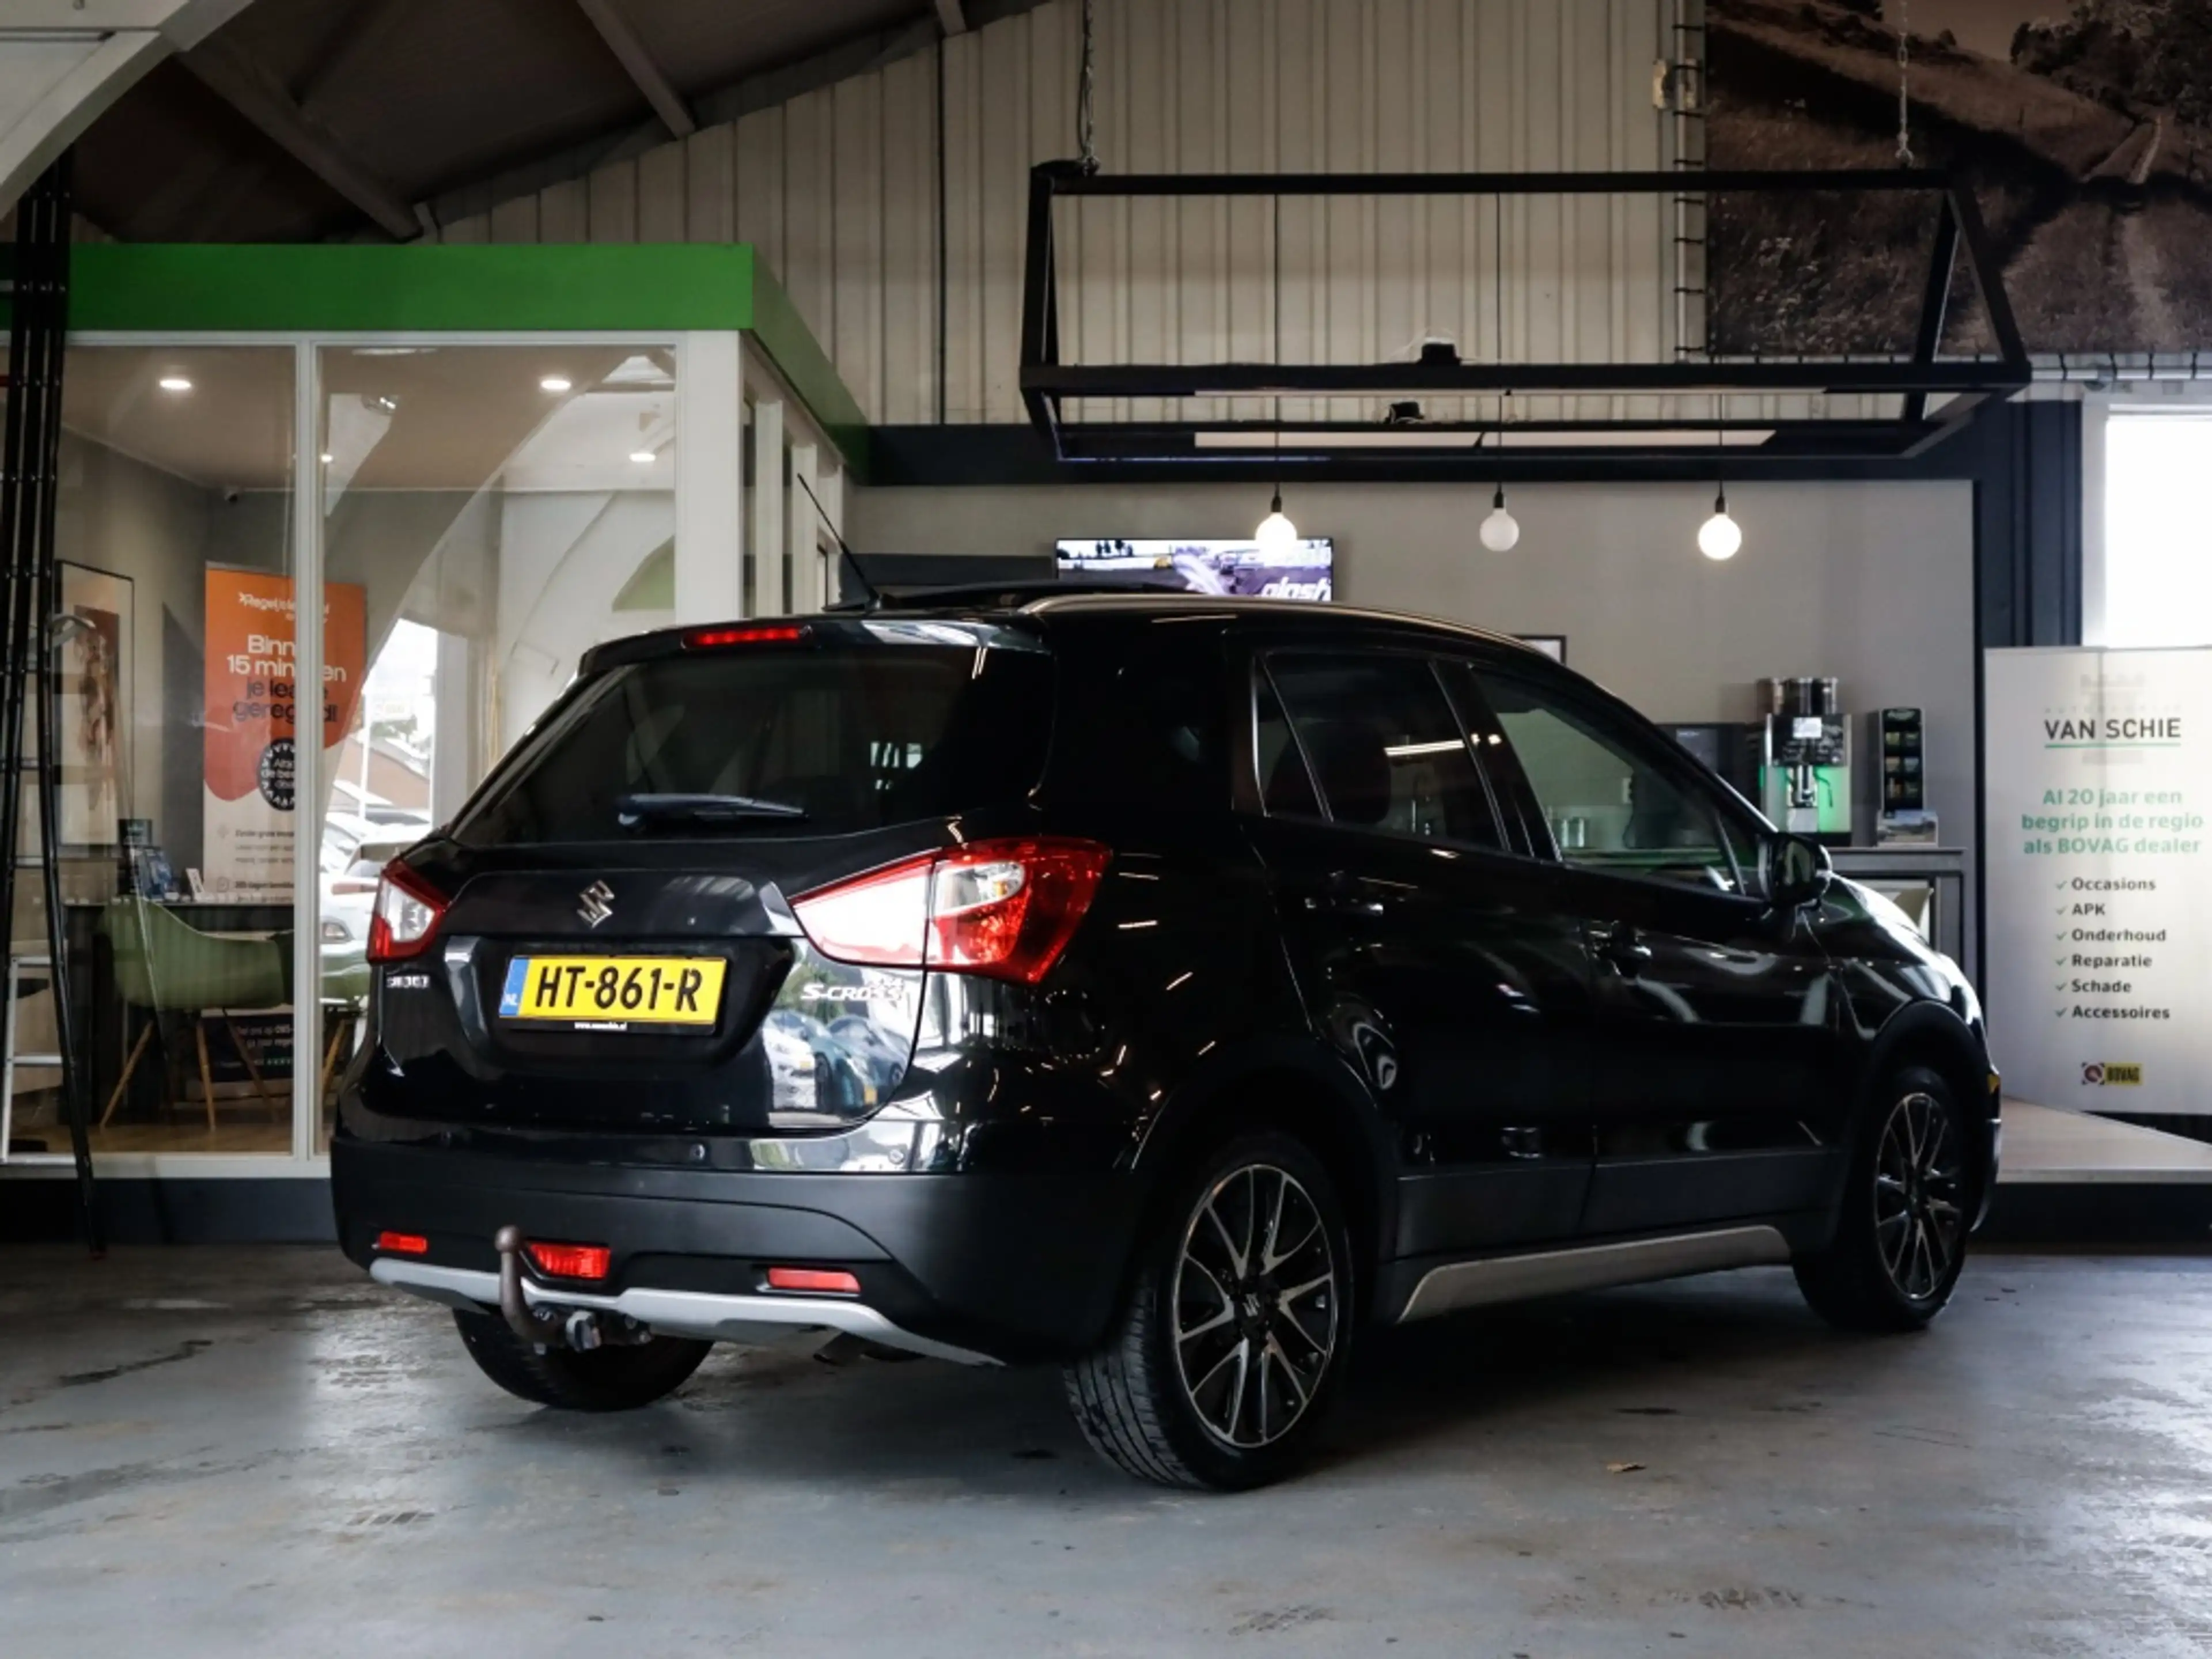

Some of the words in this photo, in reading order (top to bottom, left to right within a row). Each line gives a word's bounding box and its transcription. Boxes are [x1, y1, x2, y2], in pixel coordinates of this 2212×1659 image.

[248, 634, 296, 657] Binn
[227, 655, 251, 675] 15
[255, 659, 347, 682] minen
[247, 679, 264, 699] je
[2044, 719, 2096, 740] VAN
[2105, 717, 2181, 739] SCHIE
[2043, 789, 2063, 805] Al
[2067, 789, 2094, 805] 20
[2099, 788, 2137, 808] jaar
[2144, 791, 2183, 805] een
[2021, 813, 2089, 832] begrip
[2094, 812, 2113, 829] in
[2118, 814, 2144, 829] de
[2148, 813, 2204, 832] regio
[2023, 839, 2053, 854] als
[2058, 838, 2128, 854] BOVAG
[2134, 838, 2202, 853] dealer
[2071, 877, 2156, 891] Occasions
[2071, 903, 2105, 916] APK
[2071, 928, 2166, 942] Onderhoud
[2071, 953, 2153, 969] Reparatie
[535, 965, 703, 1013] HT-861-R
[2071, 979, 2133, 993] Schade
[503, 993, 518, 1006] NL
[2071, 1005, 2171, 1019] Accessoires
